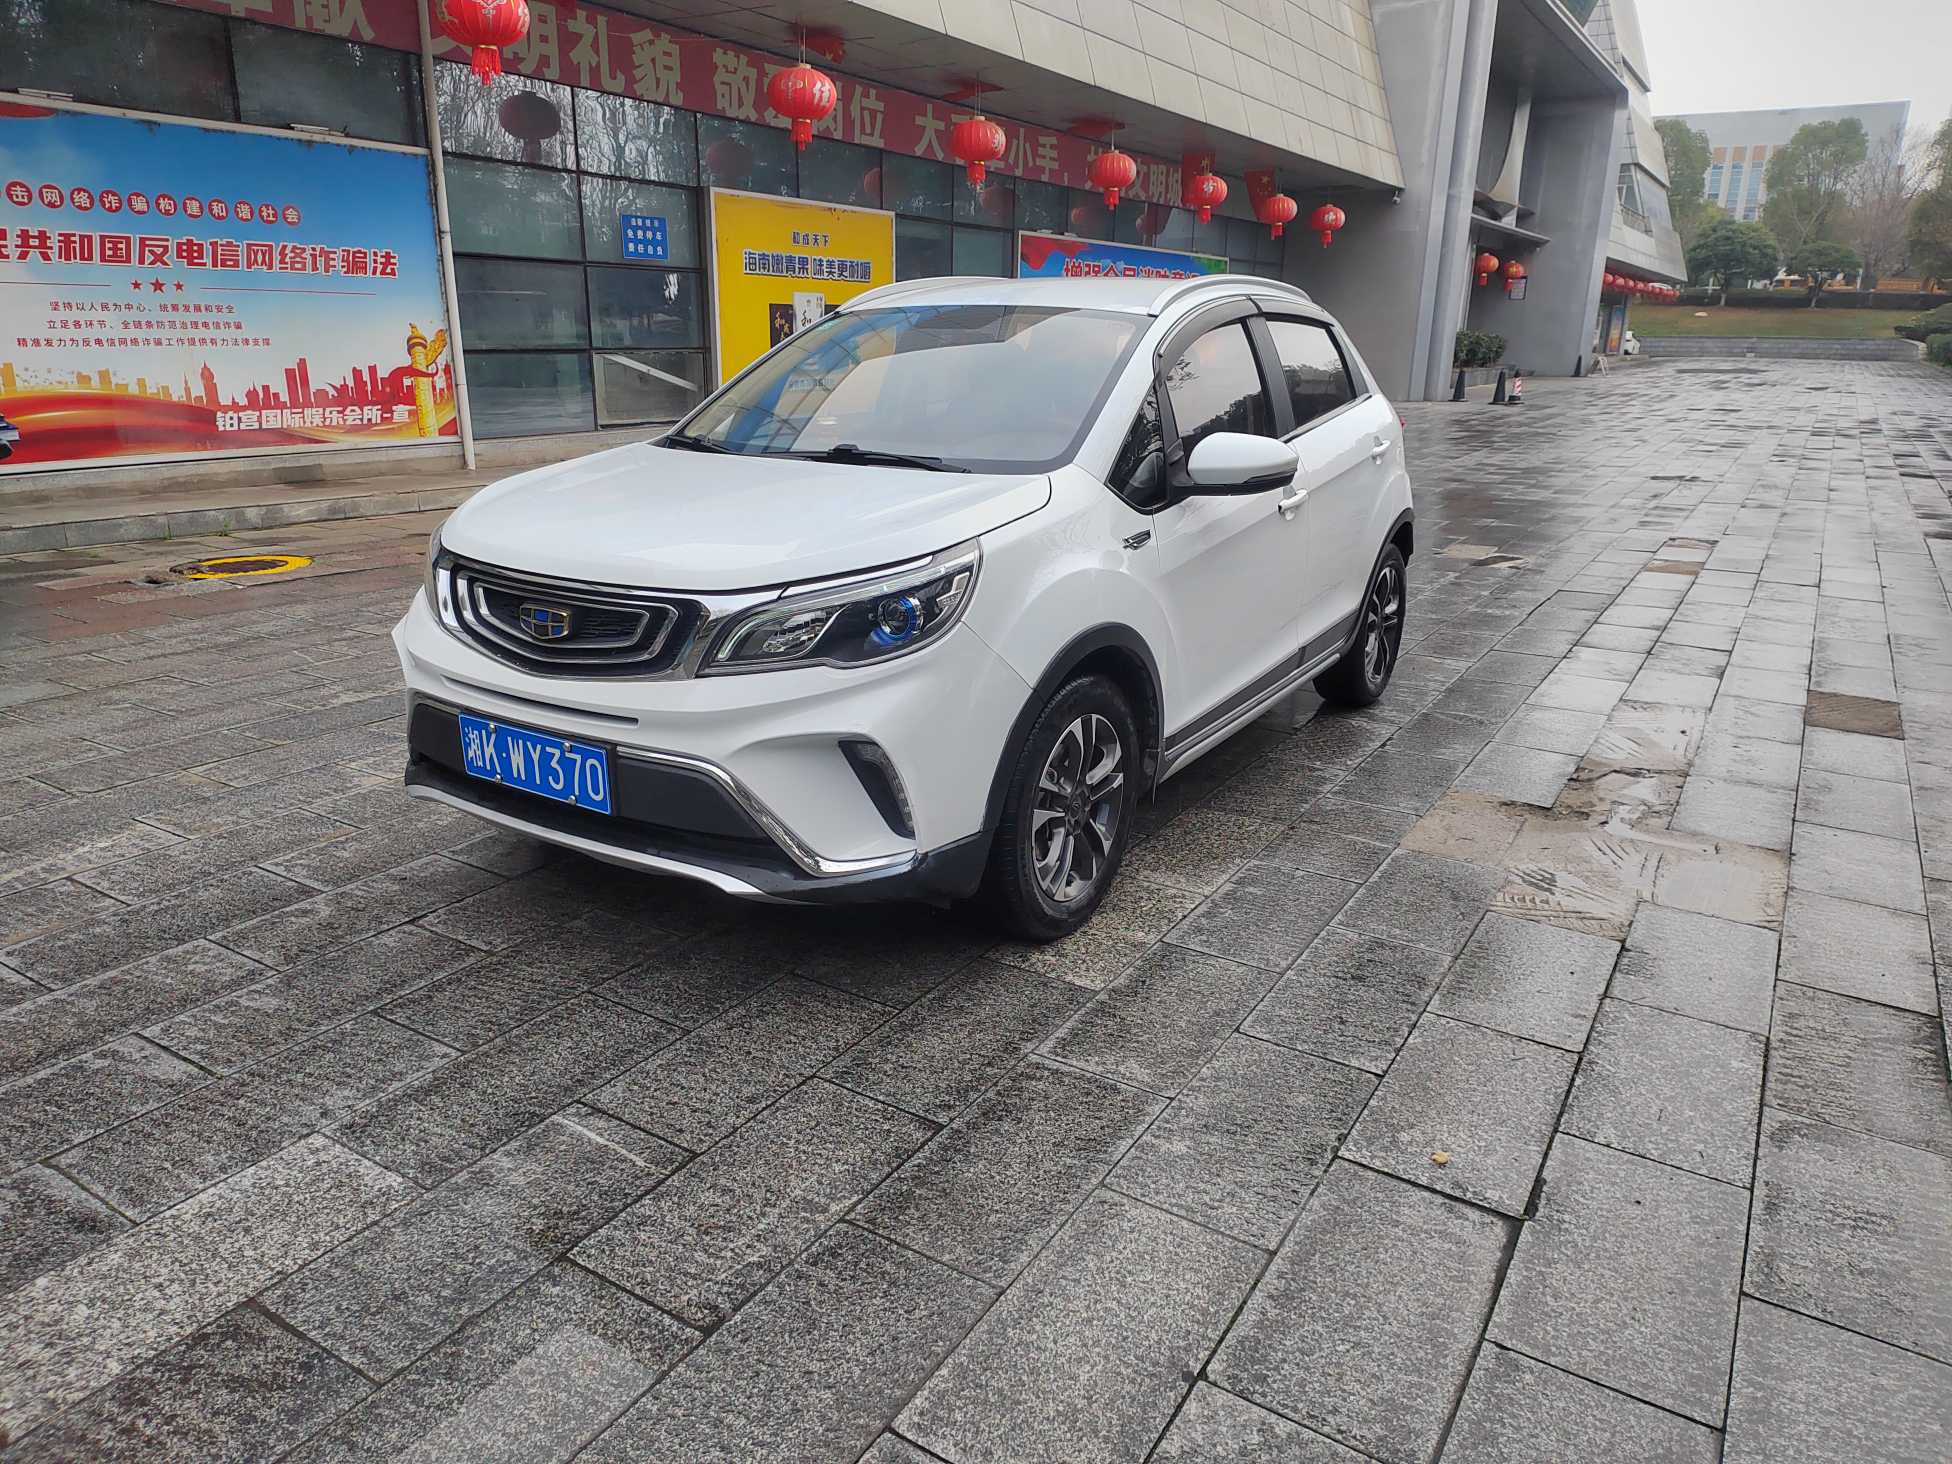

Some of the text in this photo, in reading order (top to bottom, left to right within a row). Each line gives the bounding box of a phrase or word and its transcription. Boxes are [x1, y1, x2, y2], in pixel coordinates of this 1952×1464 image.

[10, 184, 300, 224] 击网络诈骗构建和谐社会
[743, 250, 809, 276] 海南嫩青果
[49, 301, 236, 314] 坚持以人民为中心、统筹发展和安全
